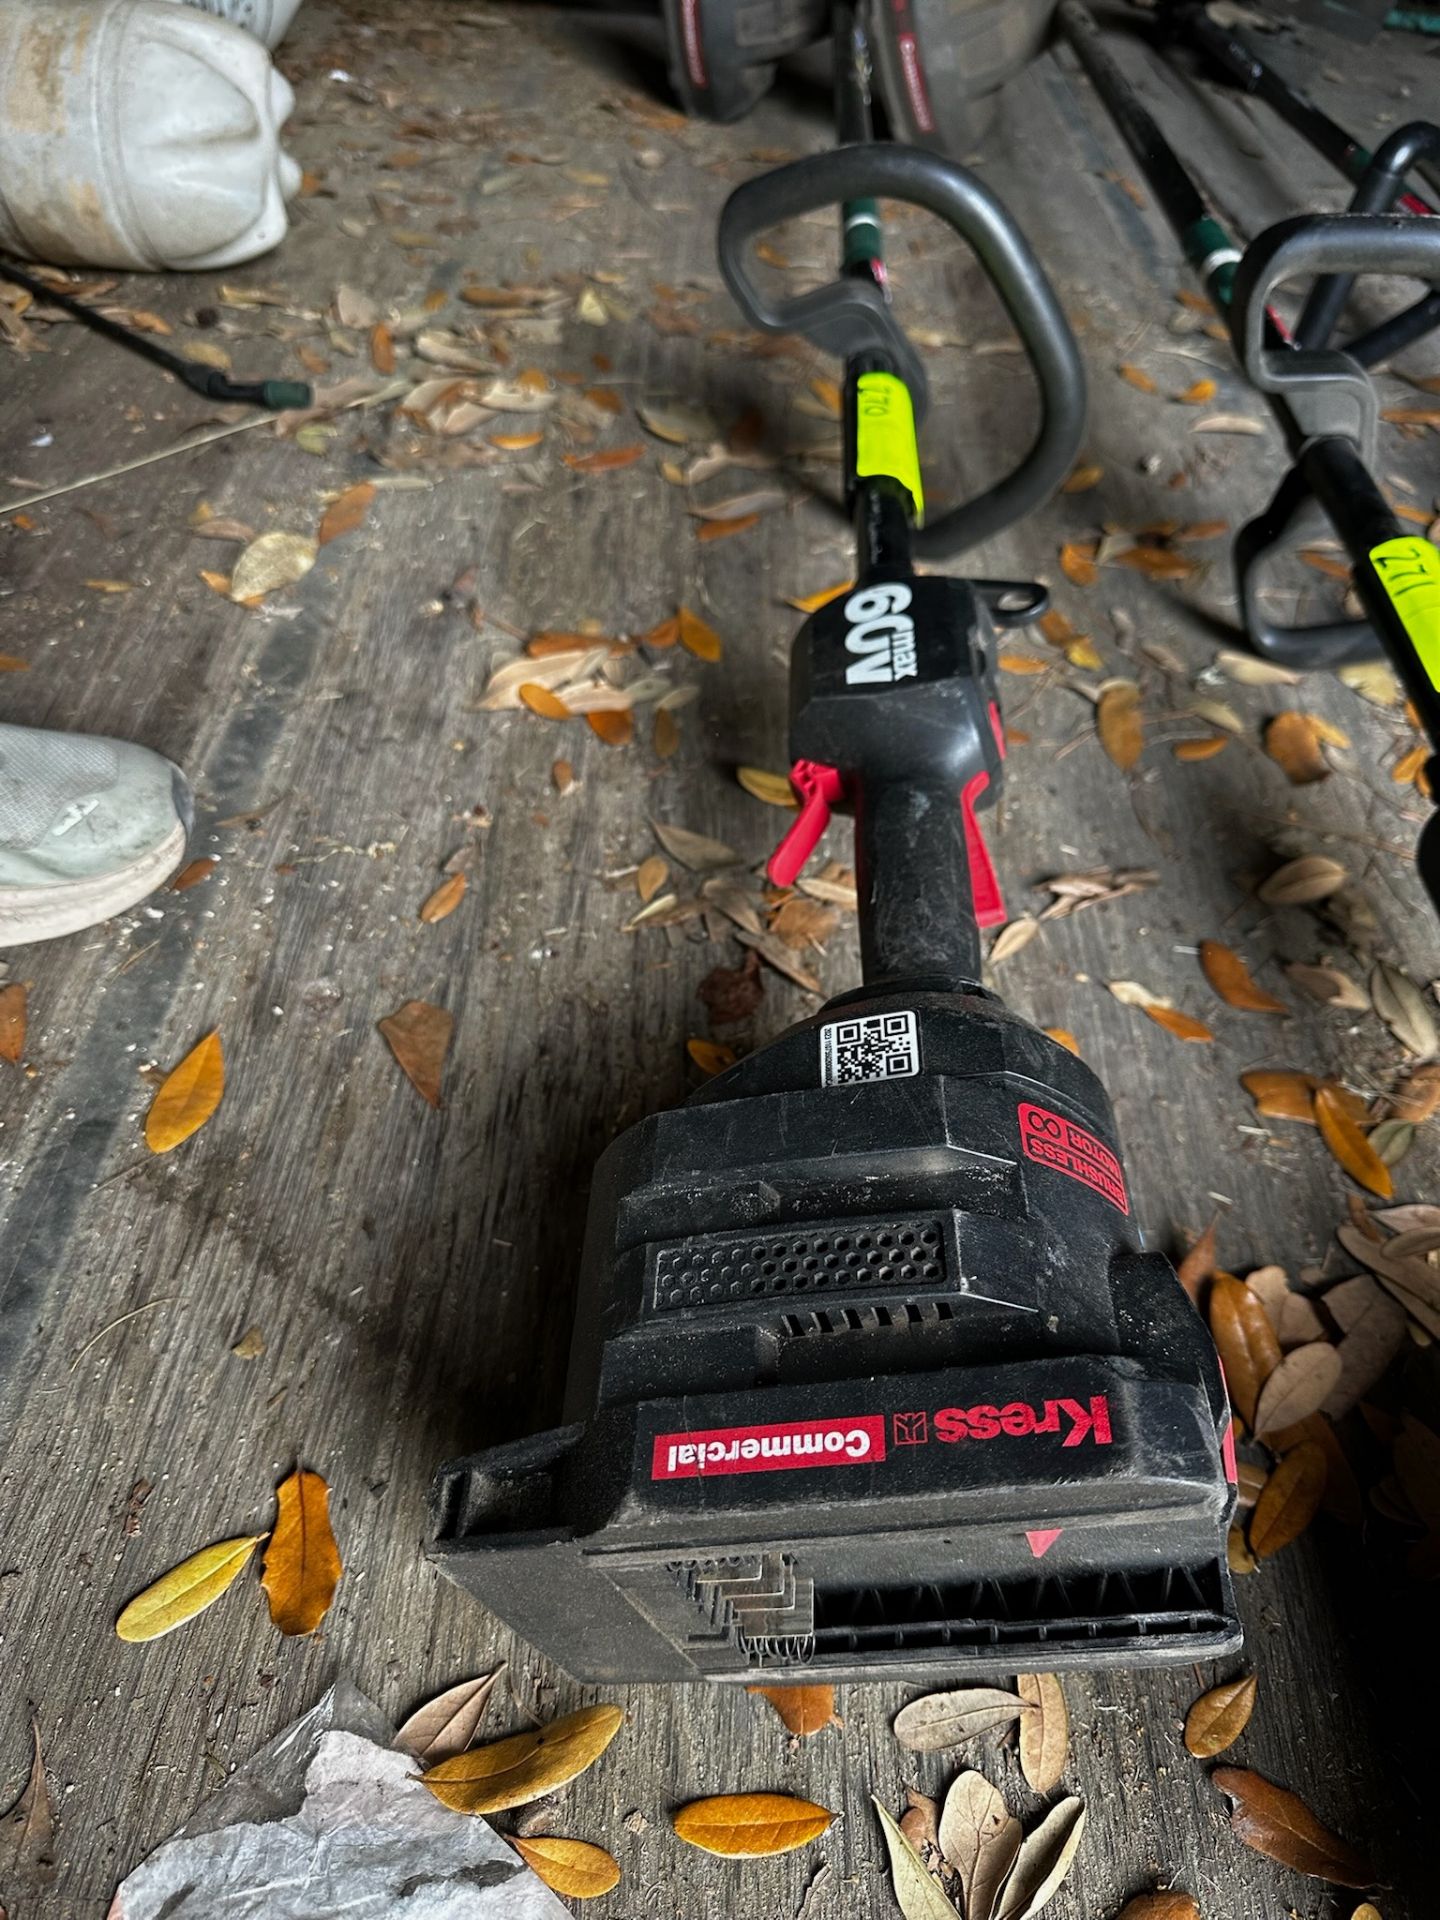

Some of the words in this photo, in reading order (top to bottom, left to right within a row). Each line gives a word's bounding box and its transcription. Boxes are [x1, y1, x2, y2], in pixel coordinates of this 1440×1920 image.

[844, 583, 915, 686] 60V
[892, 630, 919, 682] max
[1029, 1136, 1126, 1206] BRUSHLESS
[1068, 1129, 1121, 1179] MOTOR
[934, 1394, 1113, 1448] Kress
[665, 1427, 872, 1473] Commercial
